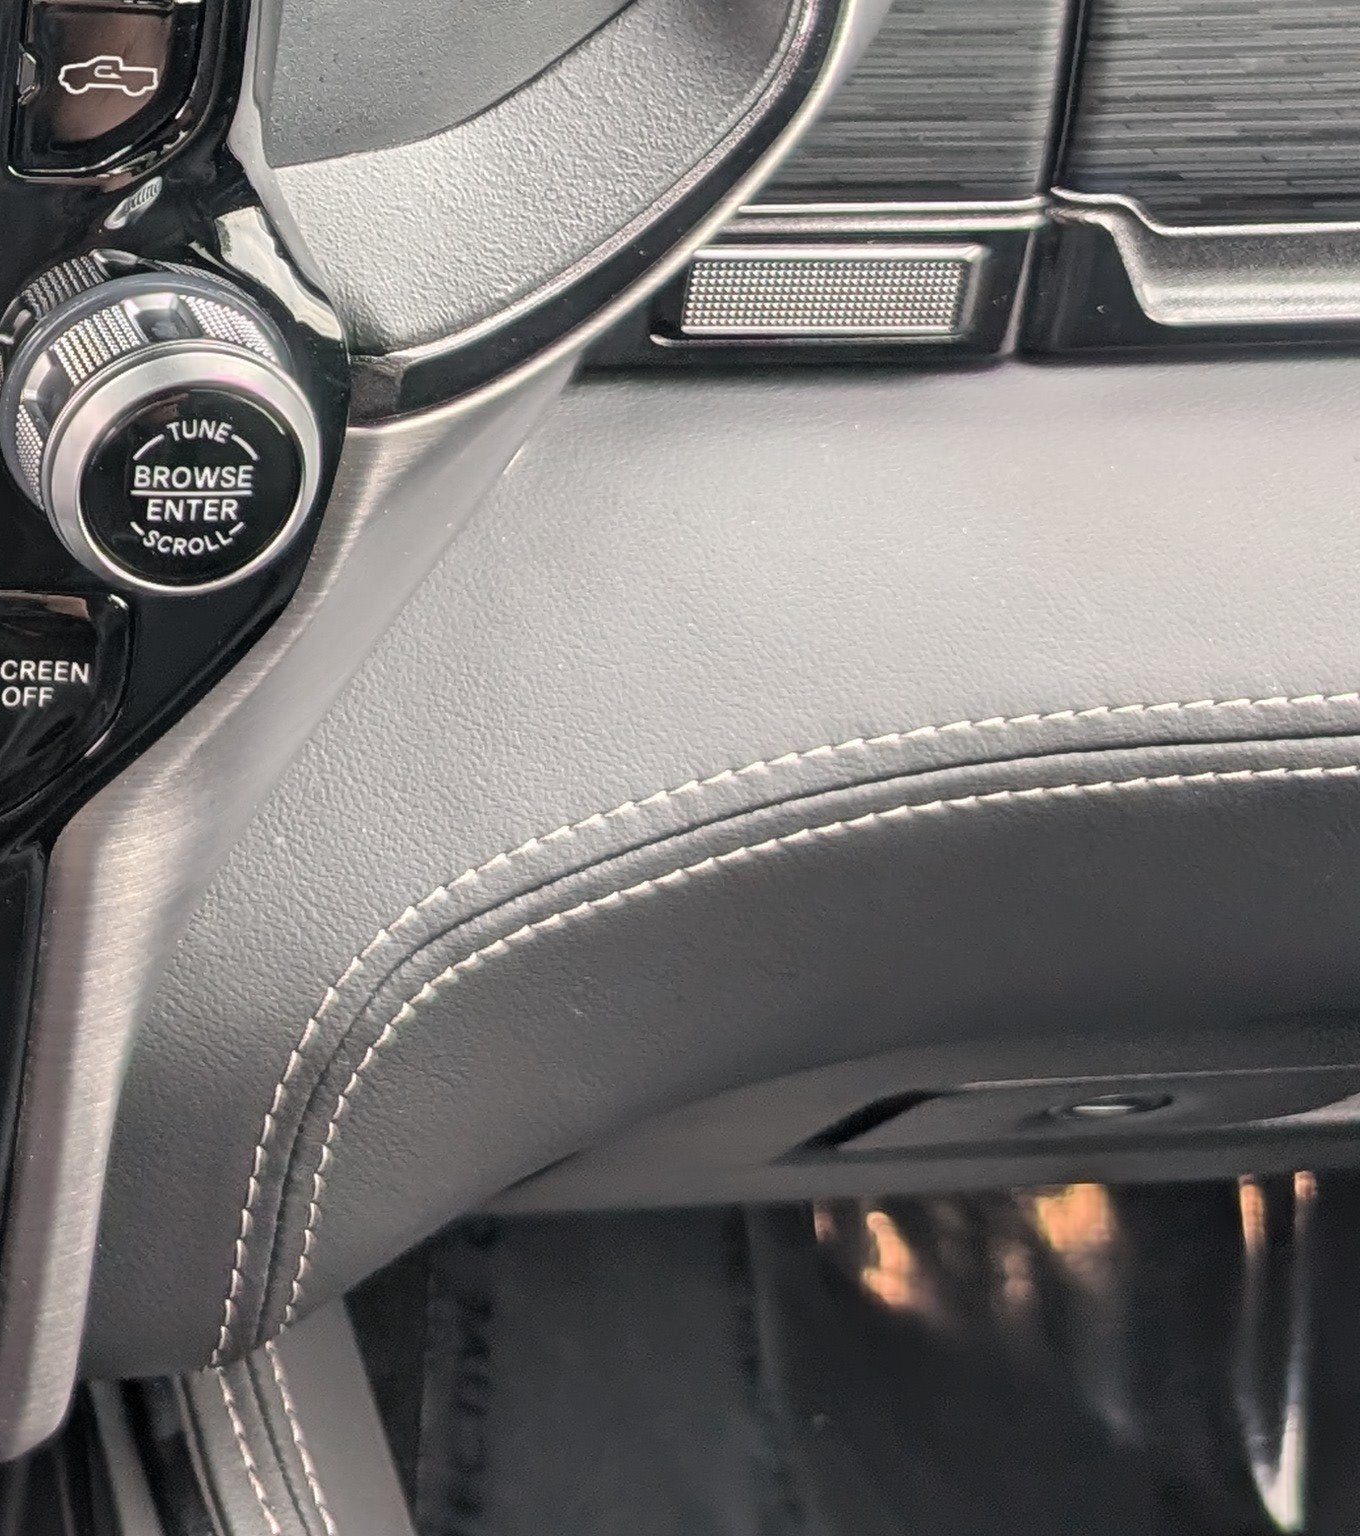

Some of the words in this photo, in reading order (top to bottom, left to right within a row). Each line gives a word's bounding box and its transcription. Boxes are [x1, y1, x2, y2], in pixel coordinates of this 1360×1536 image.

[166, 418, 233, 445] TUNE
[131, 464, 255, 490] BROWSE
[145, 498, 240, 523] ENTER
[143, 529, 233, 556] SCROLL
[1, 686, 54, 707] OFF
